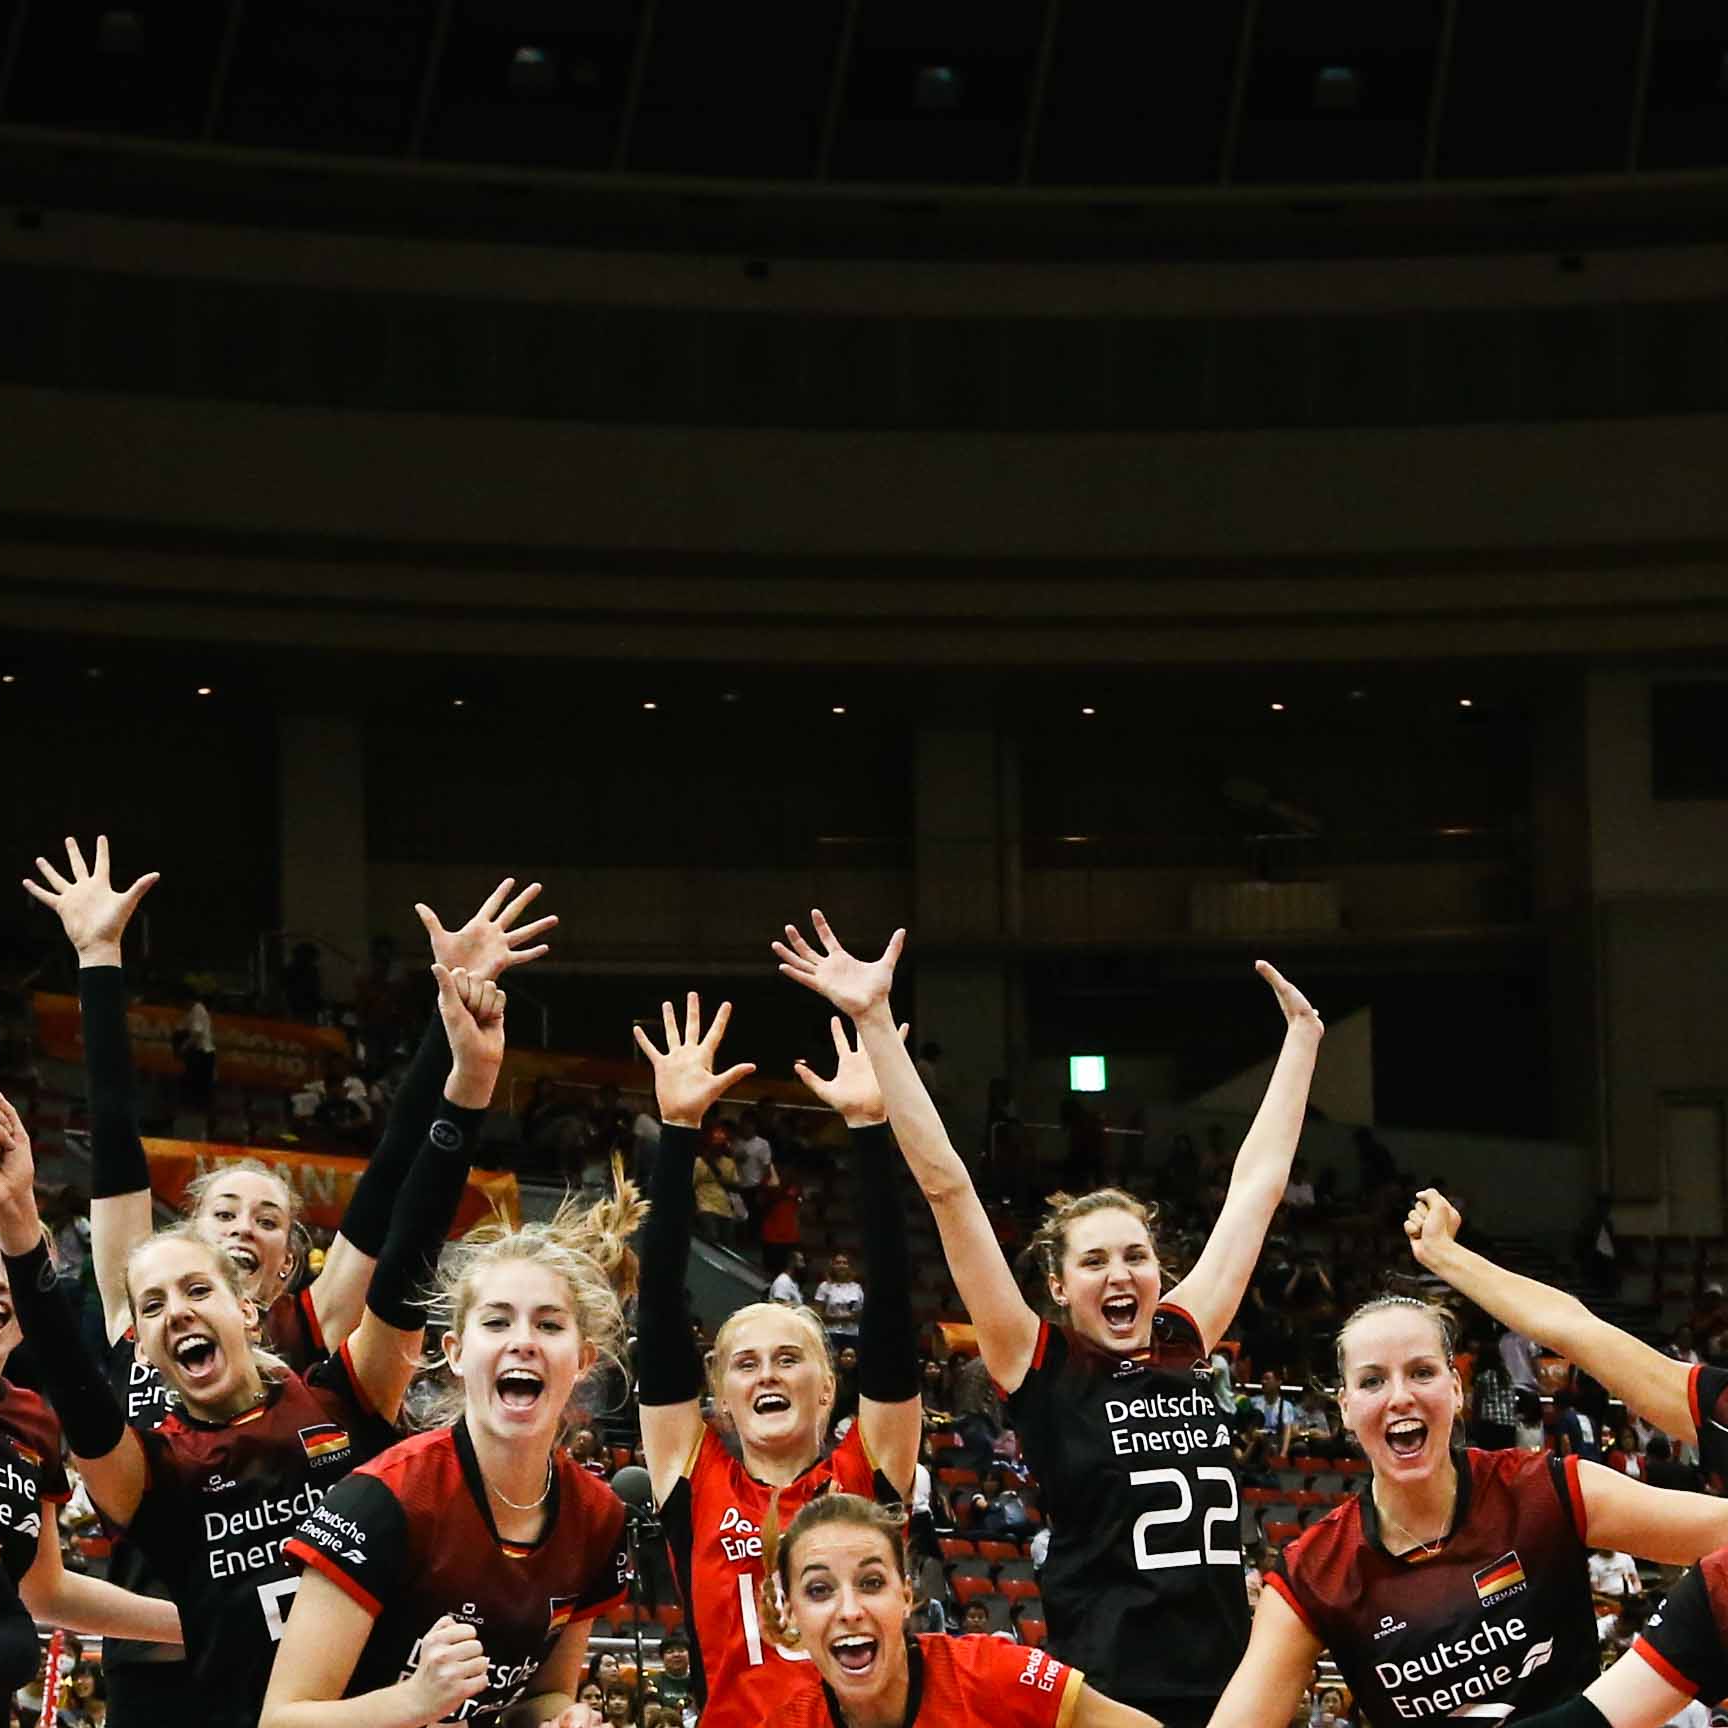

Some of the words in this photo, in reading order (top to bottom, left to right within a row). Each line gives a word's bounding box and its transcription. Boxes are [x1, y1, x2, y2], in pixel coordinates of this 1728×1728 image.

[1105, 1388, 1216, 1424] Deutsche
[1111, 1423, 1209, 1455] Energie
[298, 1519, 343, 1552] Energie
[313, 1505, 366, 1545] Deutsche
[1129, 1466, 1242, 1571] 22
[1480, 1582, 1528, 1609] GERMANY
[1375, 1616, 1528, 1690] Deutsche
